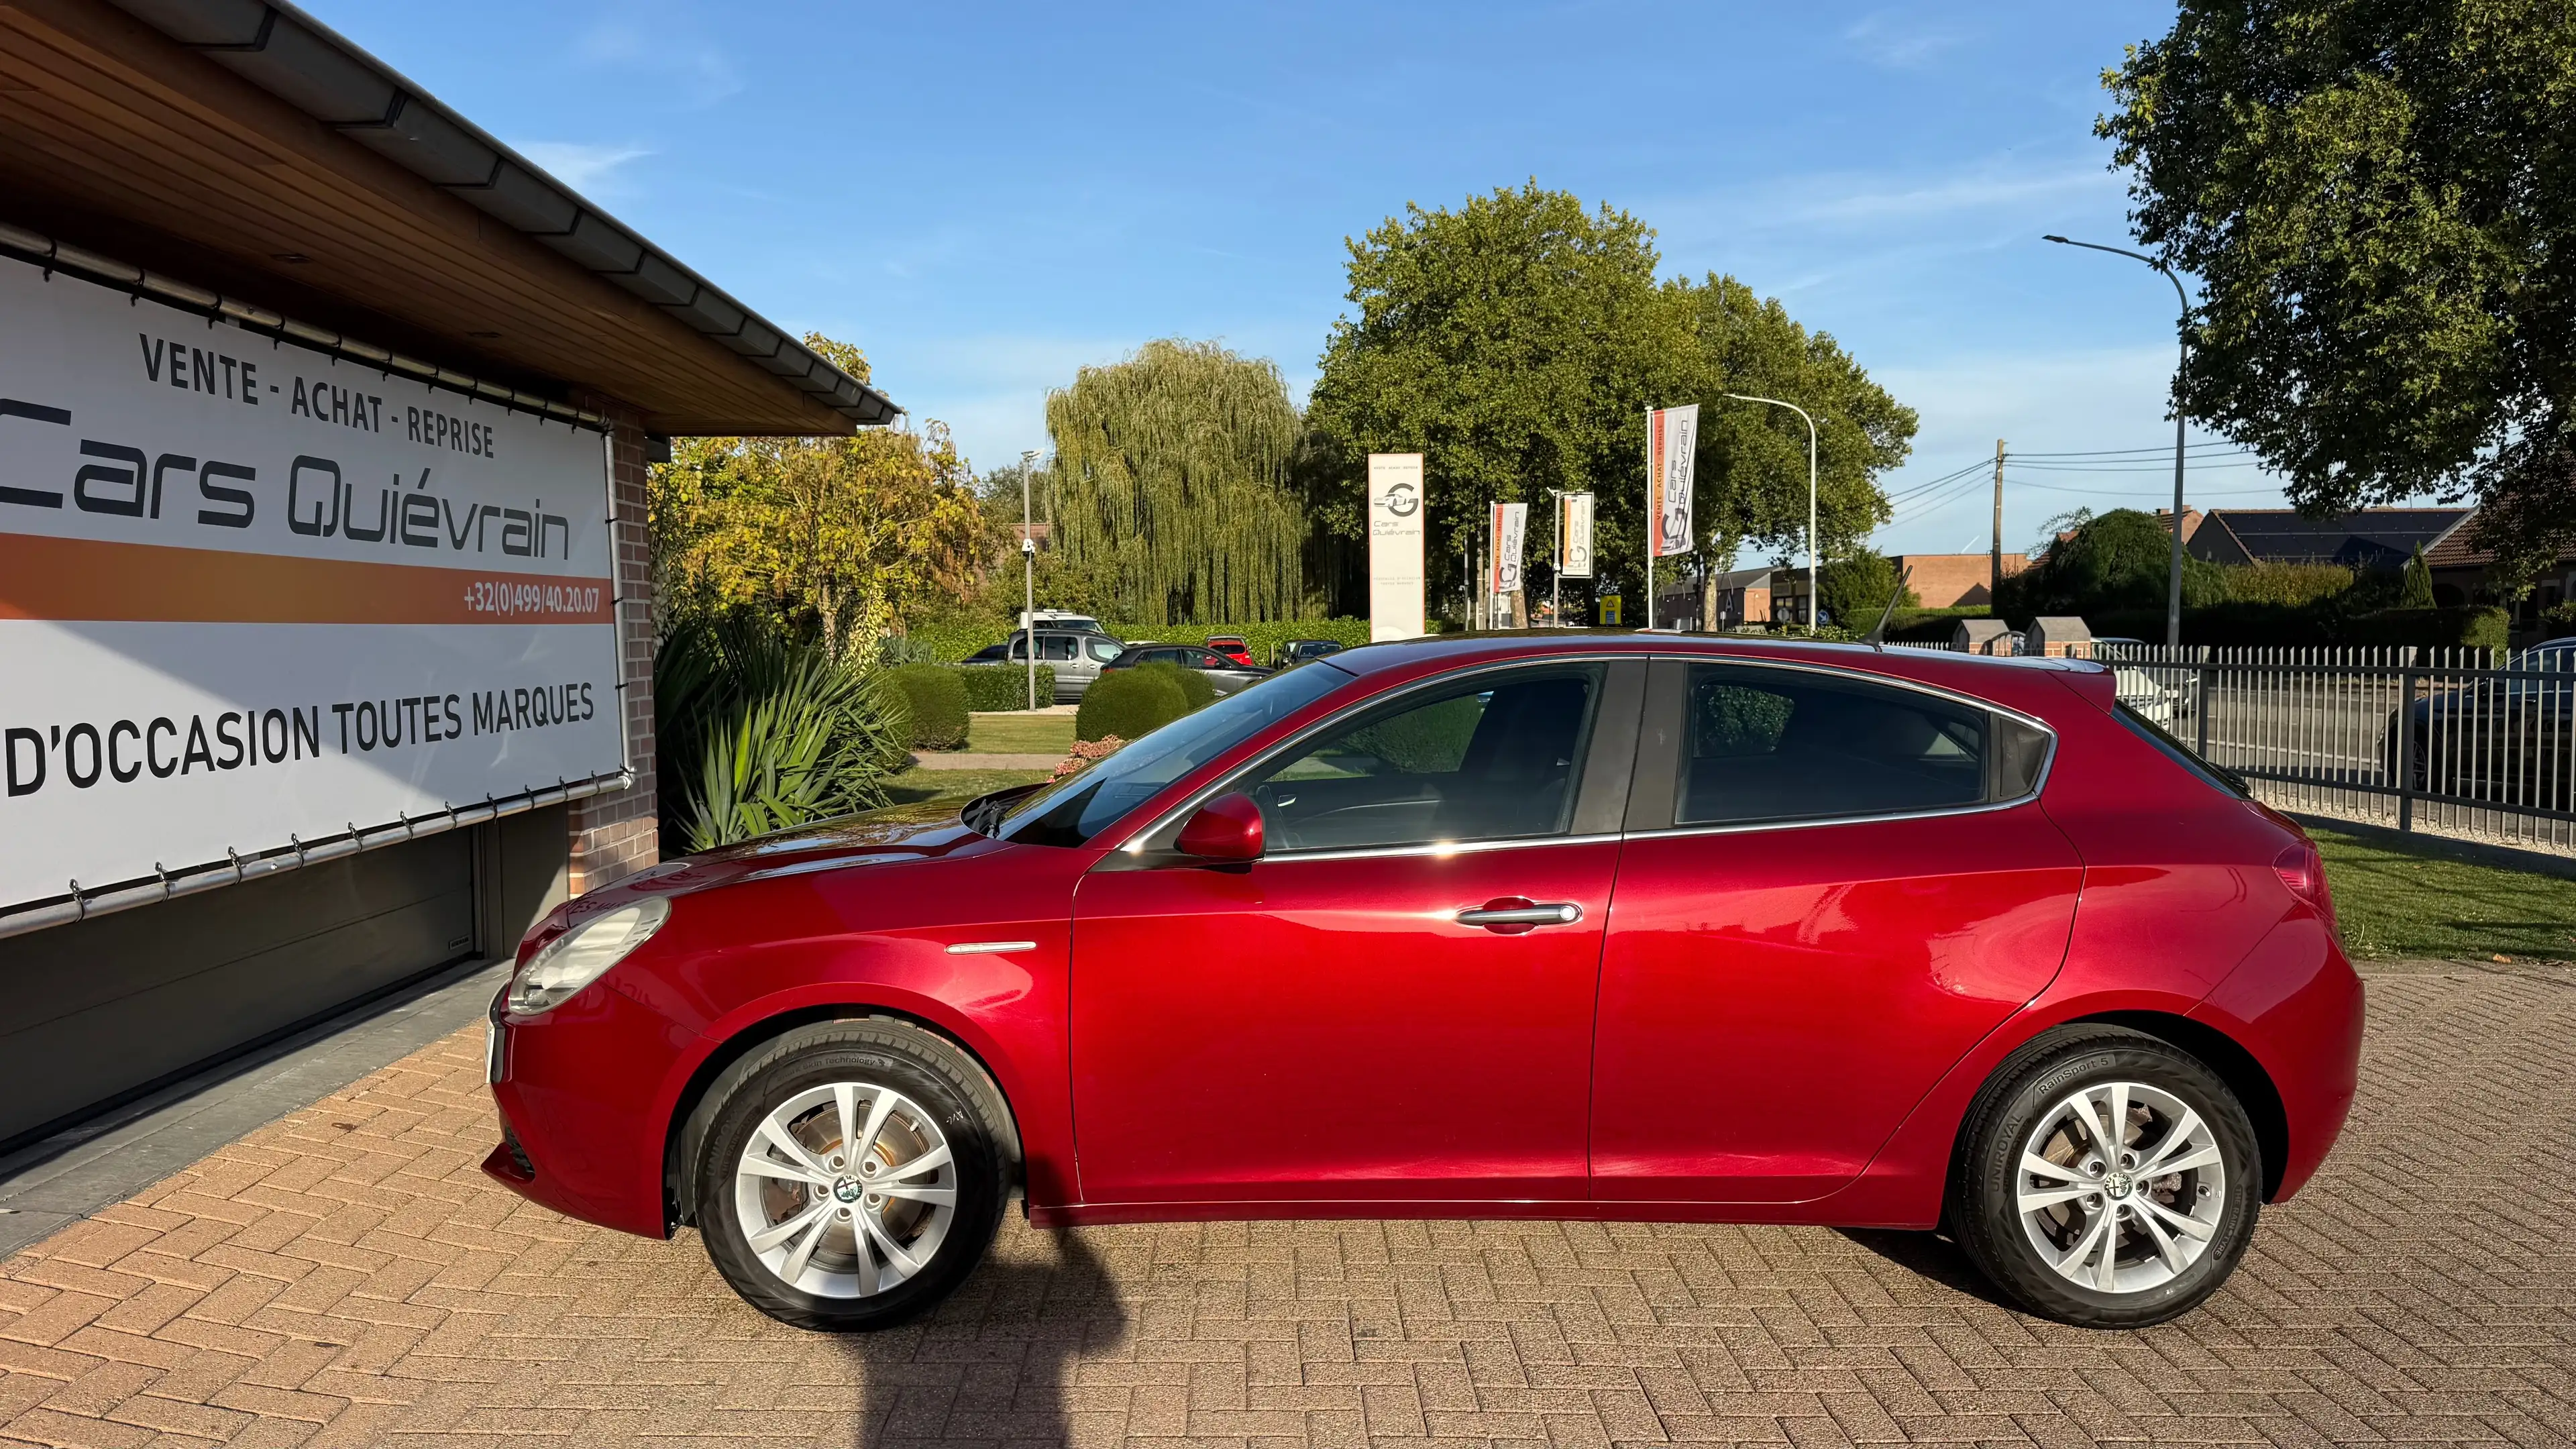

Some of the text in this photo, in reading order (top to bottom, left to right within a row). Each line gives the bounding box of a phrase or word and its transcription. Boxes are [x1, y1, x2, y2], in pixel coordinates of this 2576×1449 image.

[140, 333, 258, 405] VENTE
[292, 376, 382, 433] ACHAT
[408, 407, 493, 458] REPRISE
[0, 398, 568, 560] Cars Quiévrain
[464, 582, 598, 616] +32(0)499/40.20.07
[5, 682, 593, 797] D'OCCASION TOUTES MARQUES
[824, 1057, 875, 1066] Technology
[2038, 1057, 2108, 1094] RainSport 5
[1990, 1115, 2024, 1191] UNIROYAL
[2214, 1187, 2242, 1257] THE RAIN TYRE
